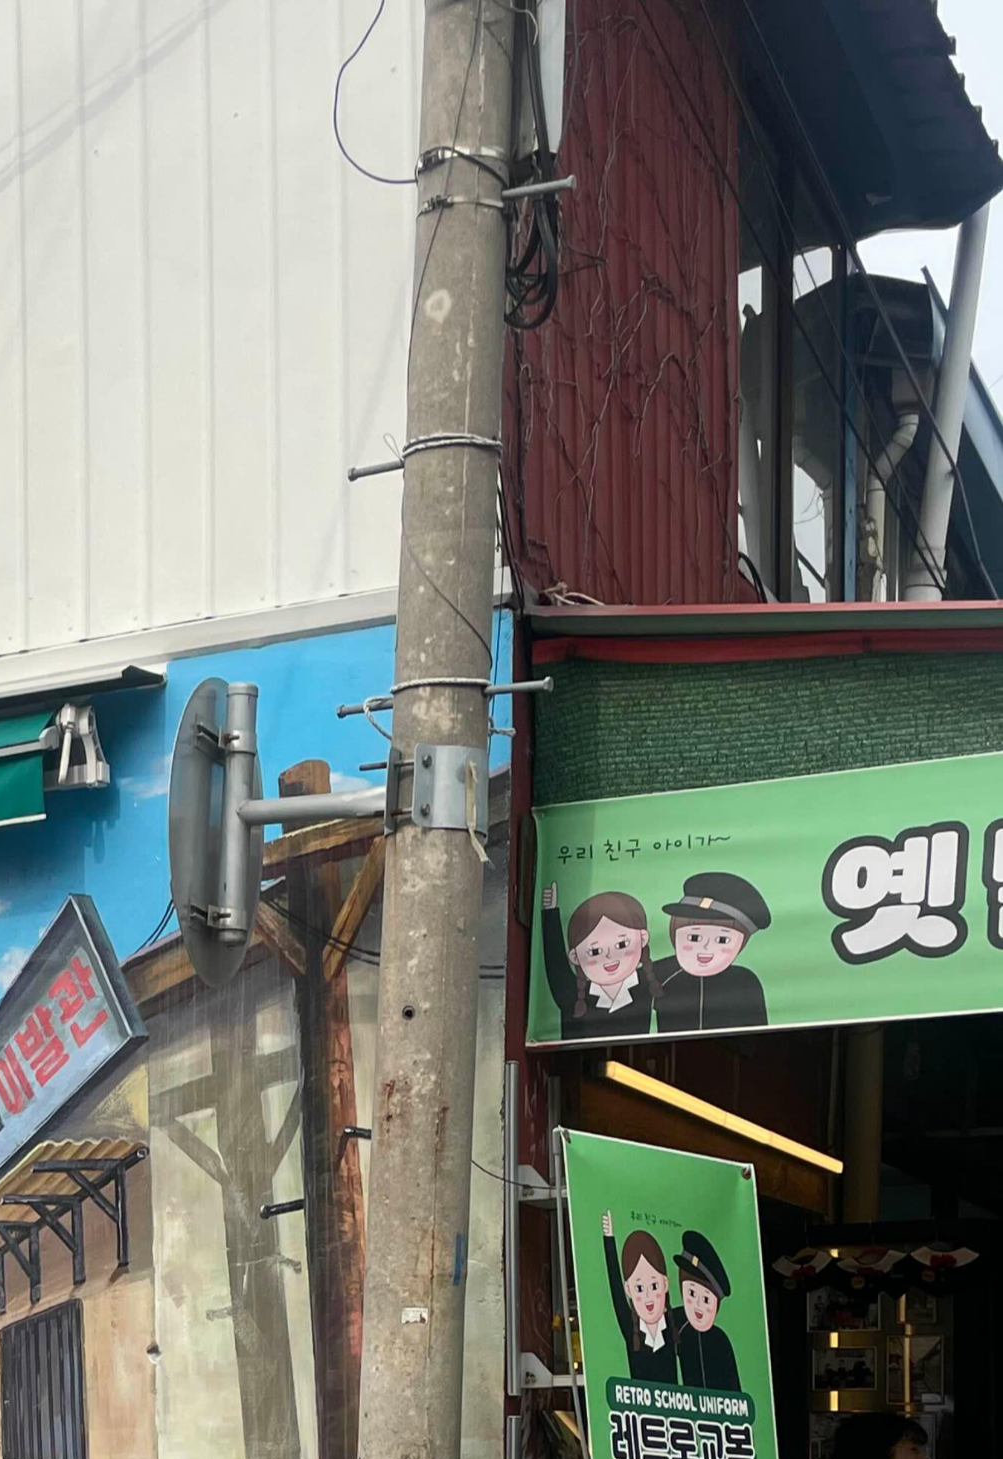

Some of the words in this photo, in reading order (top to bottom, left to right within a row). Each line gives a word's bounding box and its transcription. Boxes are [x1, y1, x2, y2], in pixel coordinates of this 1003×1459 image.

[557, 844, 594, 865] 우리
[603, 838, 641, 862] 친구
[653, 834, 731, 851] 아이가~
[822, 818, 1003, 966] 옛
[615, 1384, 652, 1407] RETRO
[654, 1389, 698, 1412] SCHOOL
[699, 1395, 749, 1417] UNIFORM
